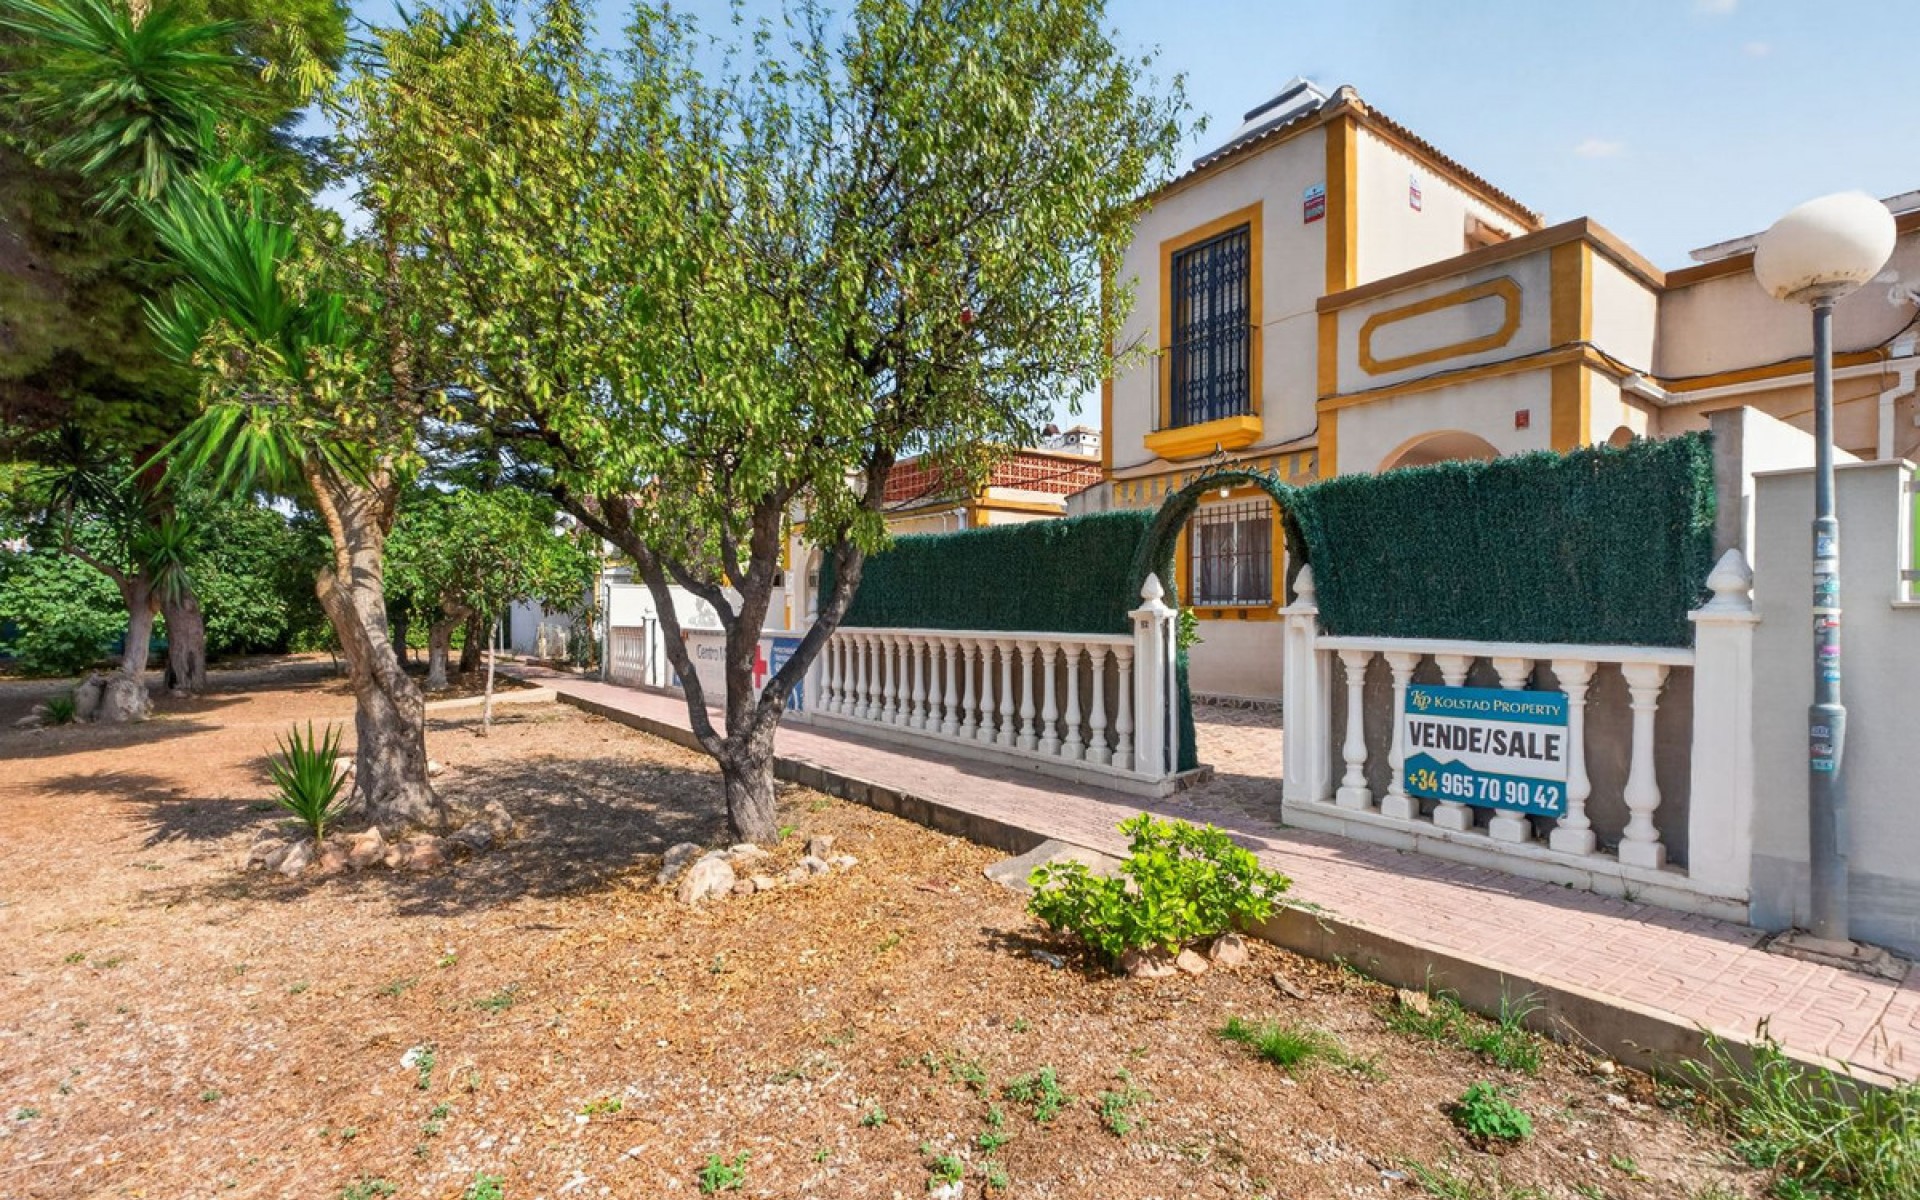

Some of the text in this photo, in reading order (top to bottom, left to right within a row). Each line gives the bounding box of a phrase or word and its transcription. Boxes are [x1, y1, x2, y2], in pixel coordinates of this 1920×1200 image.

[1434, 696, 1561, 716] KOLSTAD PROPERTY
[1409, 721, 1561, 762] VENDE/SALE
[1408, 769, 1559, 810] +34 965 70 90 42
